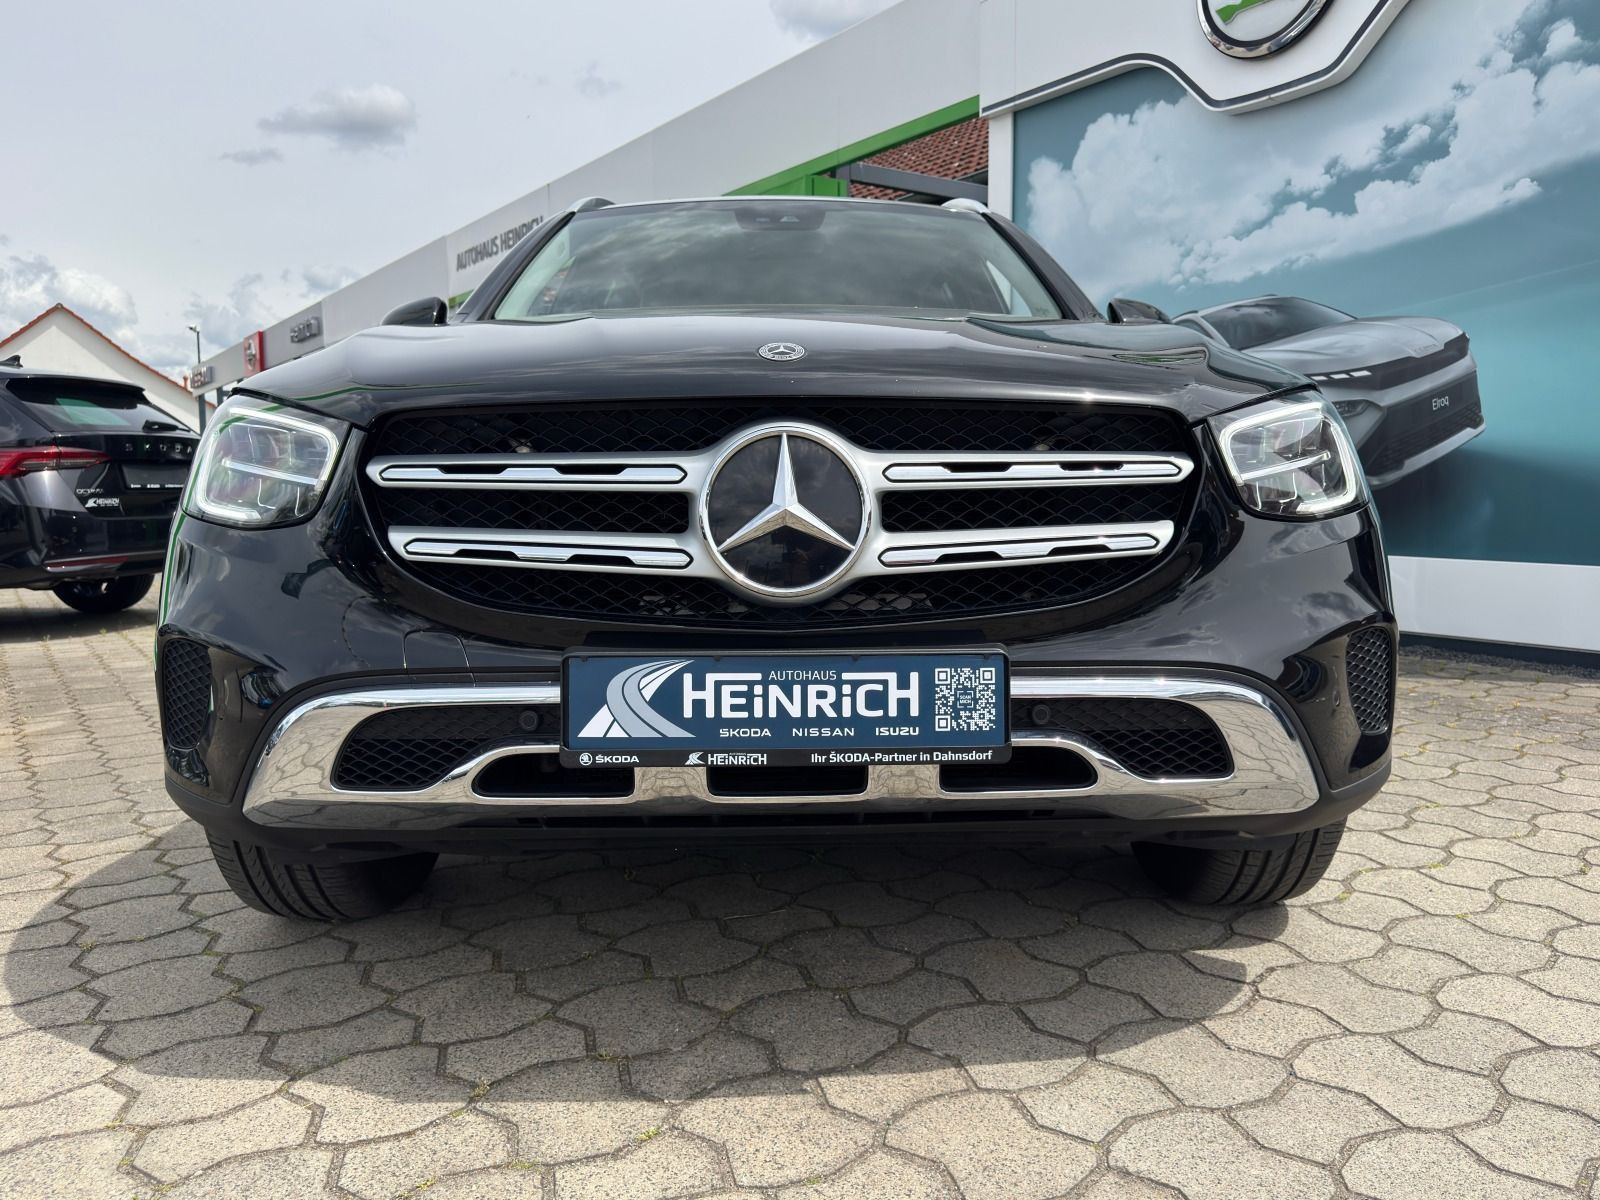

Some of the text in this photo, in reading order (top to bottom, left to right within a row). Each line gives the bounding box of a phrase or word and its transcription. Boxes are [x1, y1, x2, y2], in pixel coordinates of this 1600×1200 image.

[457, 235, 498, 271] AUTOHAUS
[1432, 396, 1449, 410] Elroq
[768, 670, 837, 681] AUTOHAUS
[792, 727, 855, 737] NISSAN
[875, 726, 919, 736] ISUZU
[595, 754, 640, 764] ŠKODA
[811, 750, 993, 763] Ihr ŠKODA-Partner in Dahnsdorf
